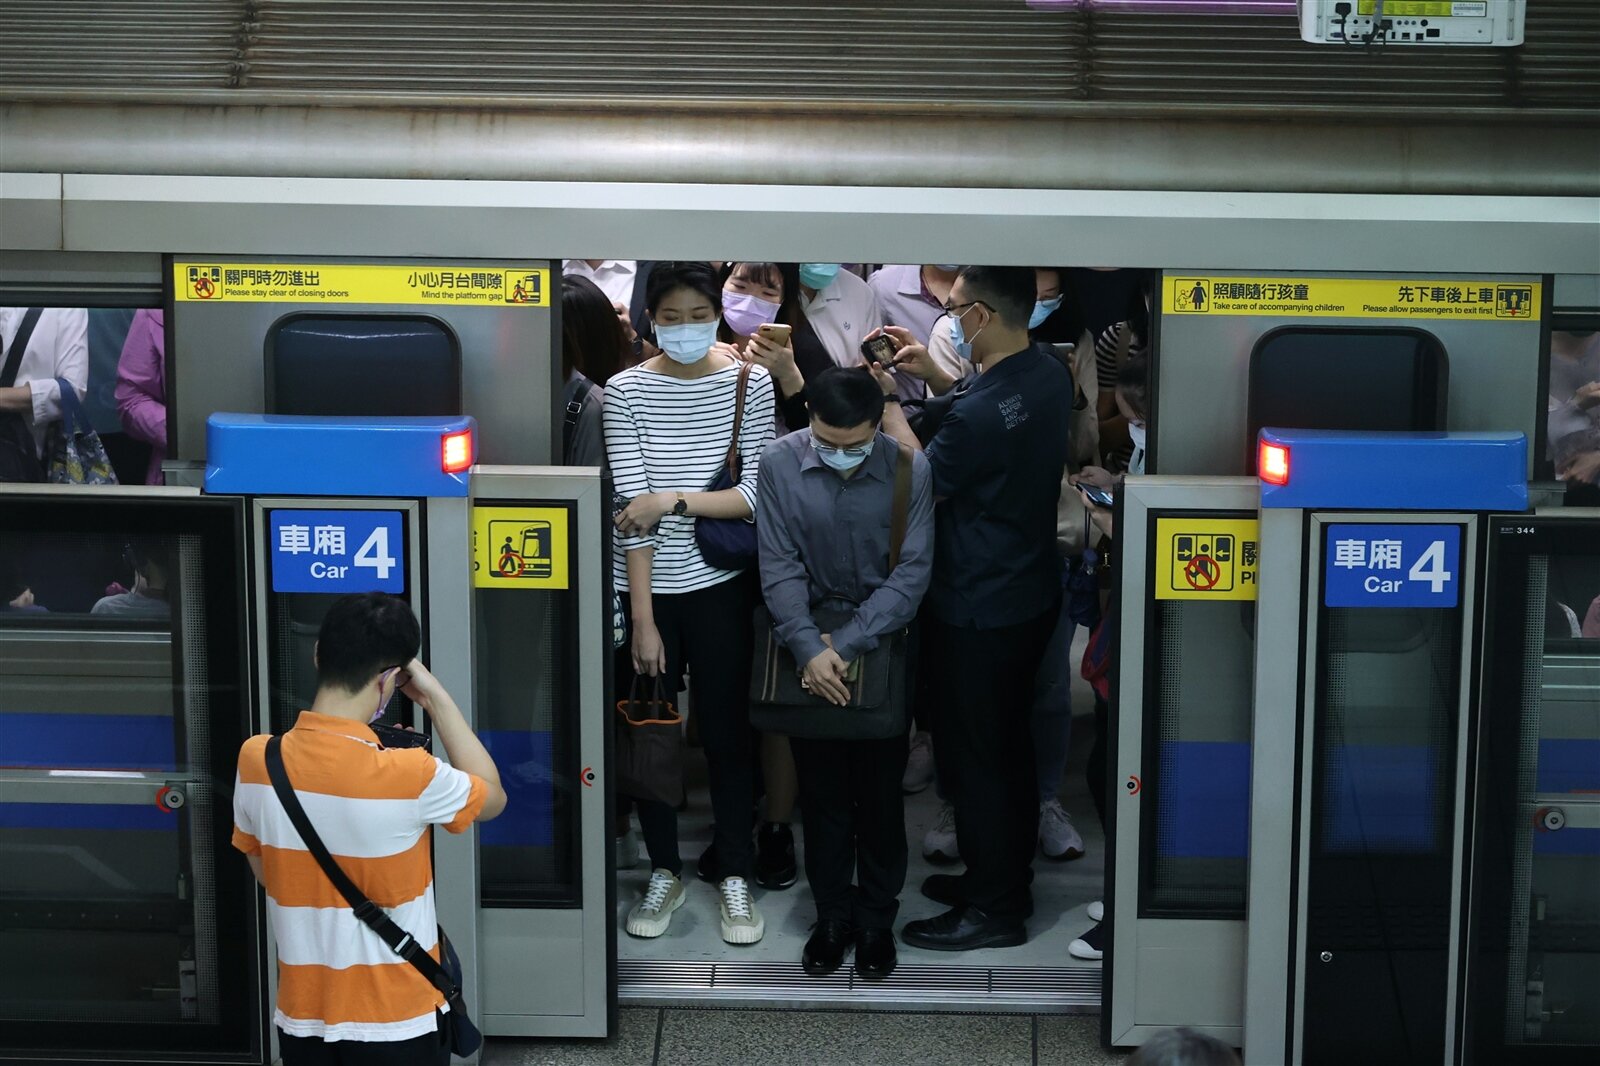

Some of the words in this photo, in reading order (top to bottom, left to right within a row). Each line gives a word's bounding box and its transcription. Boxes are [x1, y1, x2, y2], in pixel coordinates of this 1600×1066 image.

[224, 269, 320, 286] 關門時勿進出
[407, 271, 503, 290] 小心月台間隙
[225, 288, 250, 297] Please
[252, 289, 267, 298] stay
[269, 289, 287, 297] clear
[289, 289, 297, 297] of
[298, 289, 325, 299] closing
[327, 289, 349, 298] doors
[422, 291, 440, 299] Mind
[442, 291, 454, 299] the
[455, 291, 487, 300] platform
[488, 293, 503, 301] gap
[1213, 283, 1309, 301] 照顧隨行孩童
[1398, 286, 1494, 304] 先下車後上車
[1213, 302, 1230, 310] Take
[1250, 302, 1258, 310] of
[1258, 303, 1313, 313] accompanying
[1314, 303, 1345, 312] children
[1363, 305, 1388, 313] Please
[1388, 305, 1409, 313] allow
[1410, 306, 1453, 315] passengers
[1454, 306, 1463, 314] to
[1463, 306, 1477, 314] exit
[1478, 306, 1493, 315] first
[1005, 411, 1018, 423] AND
[279, 524, 346, 555] 車廂
[353, 526, 396, 579] 4
[1334, 539, 1402, 569] 車廂
[310, 561, 349, 579] Car
[1408, 540, 1451, 593] 4
[1364, 576, 1403, 593] Car
